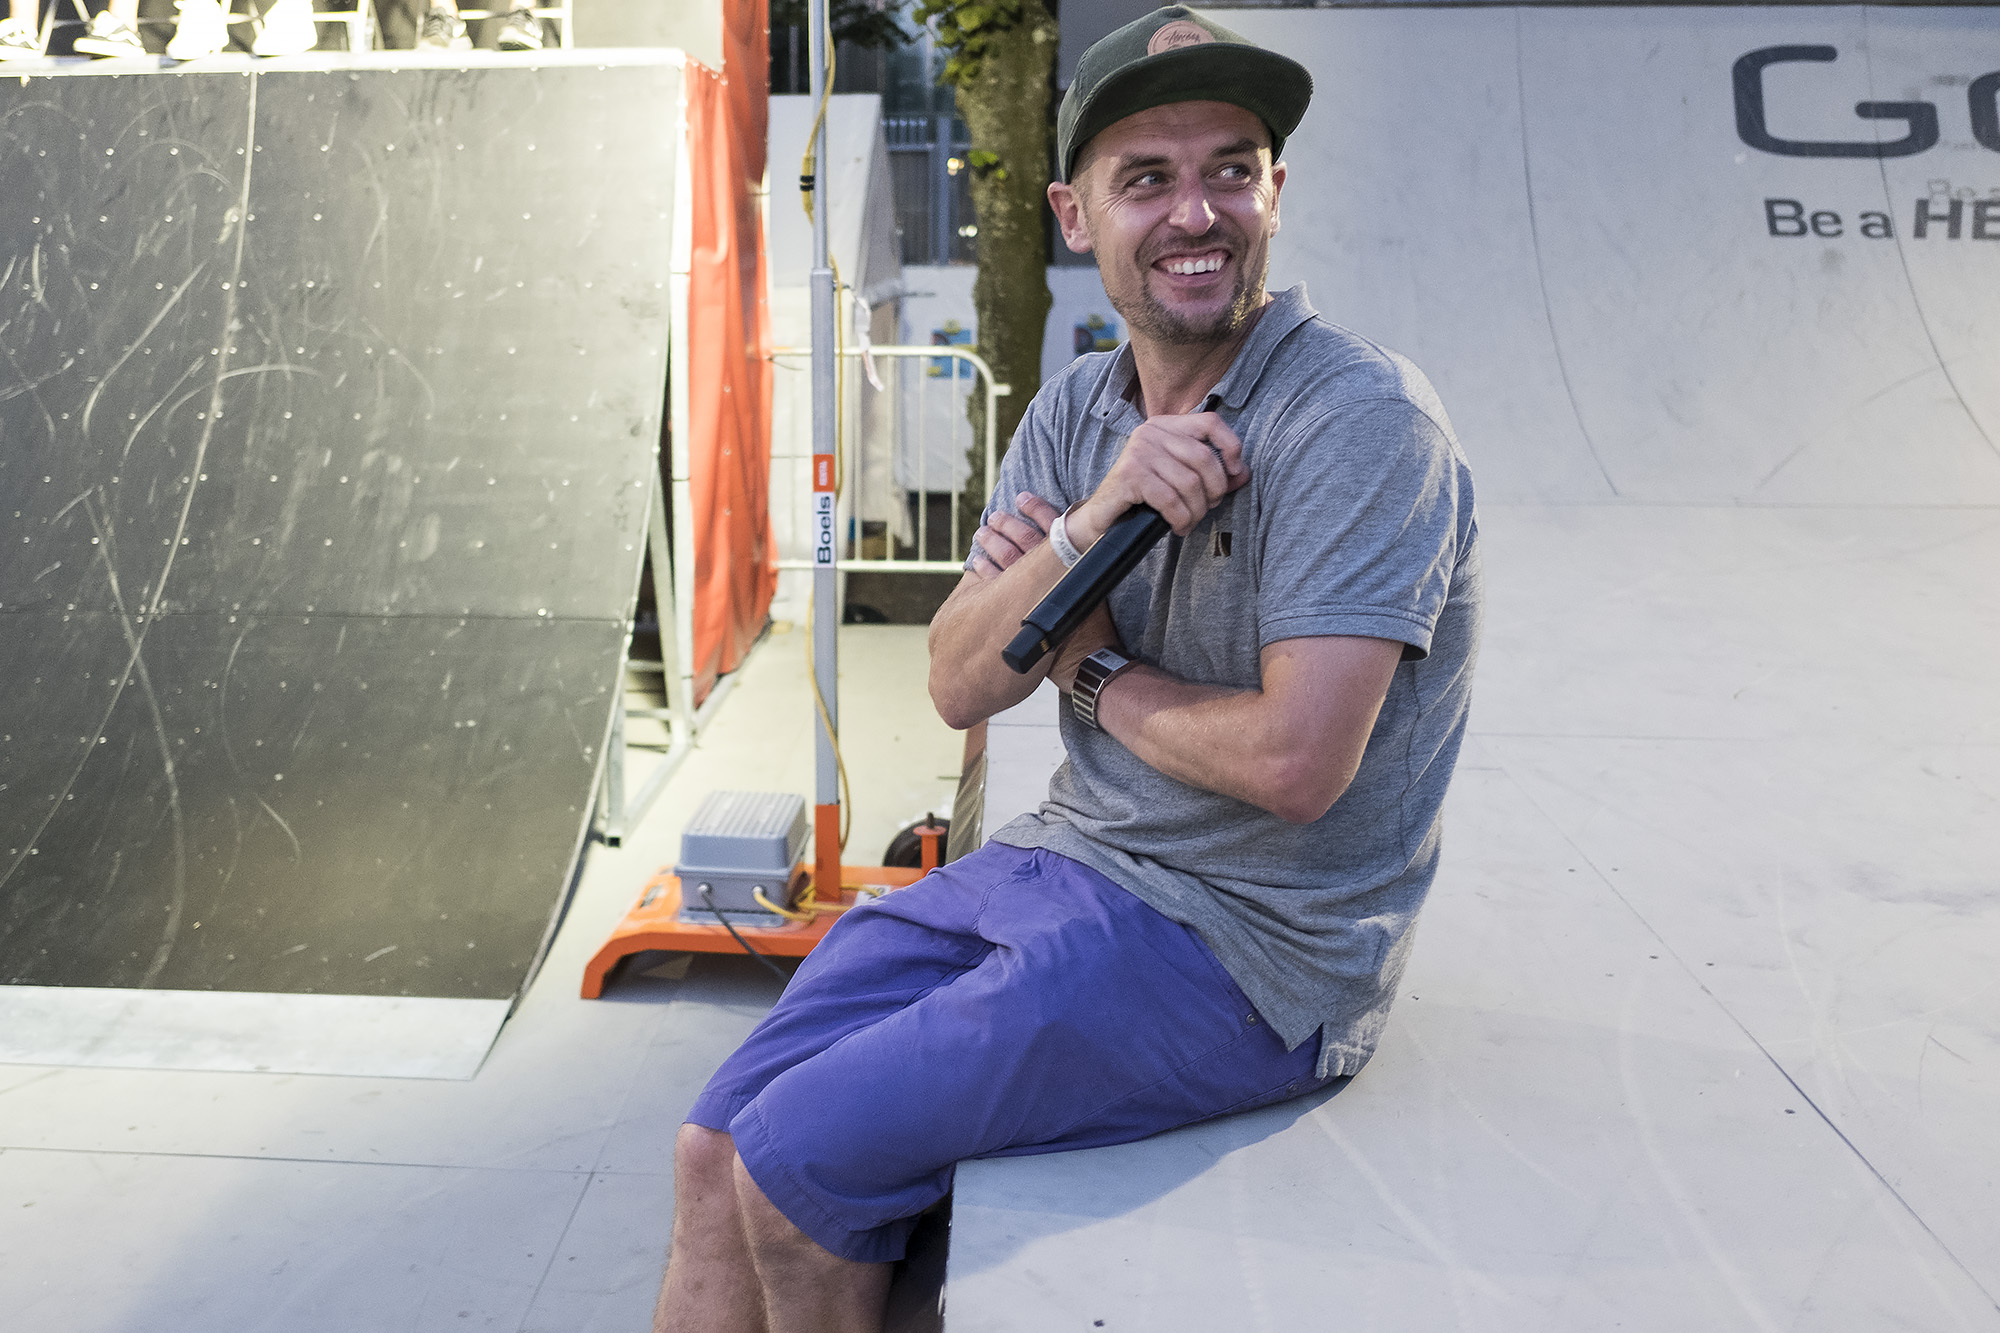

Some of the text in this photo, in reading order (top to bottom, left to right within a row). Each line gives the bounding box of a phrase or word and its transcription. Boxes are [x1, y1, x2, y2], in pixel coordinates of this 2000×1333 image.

[1732, 45, 2000, 159] G
[1764, 197, 1843, 238] Be
[1858, 210, 1893, 239] a
[816, 495, 832, 564] Boels
